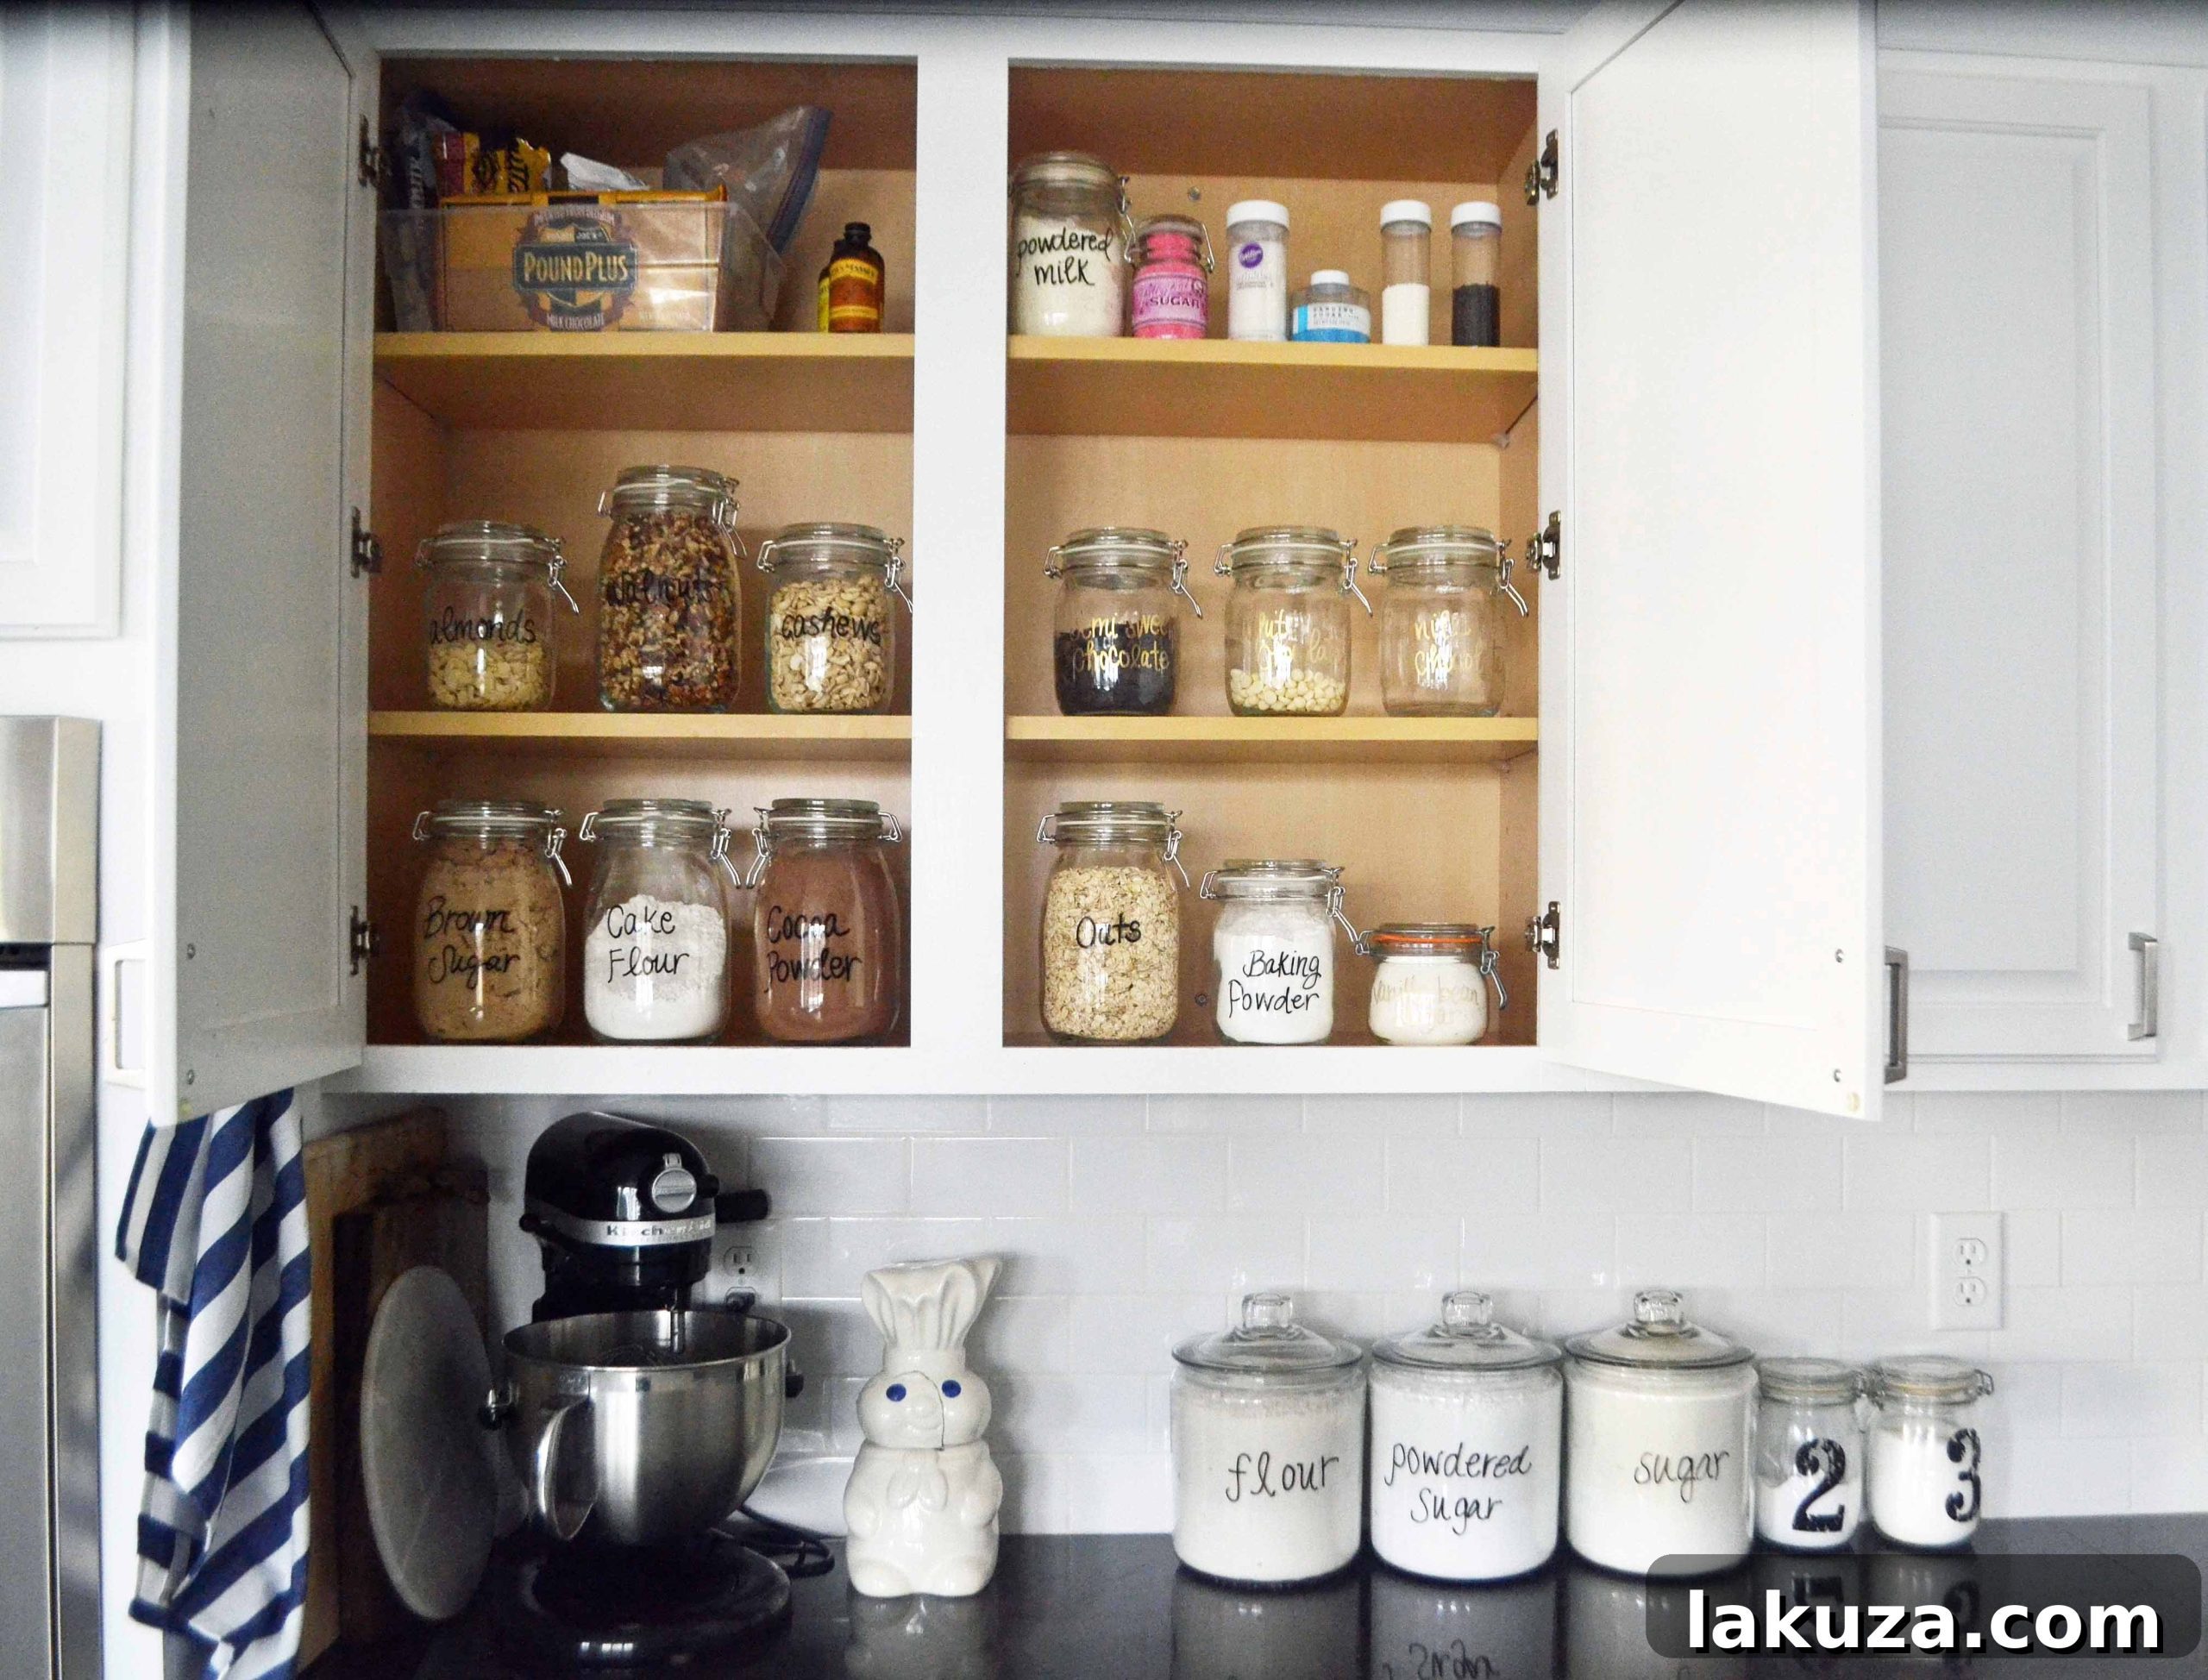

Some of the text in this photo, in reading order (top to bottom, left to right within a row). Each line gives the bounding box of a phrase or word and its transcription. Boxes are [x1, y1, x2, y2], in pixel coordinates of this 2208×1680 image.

[1017, 226, 1113, 277] powdered
[1034, 255, 1095, 285] milk
[1150, 297, 1200, 309] SUGAR
[431, 606, 536, 644] almonds
[781, 606, 881, 645] cashews
[1125, 613, 1174, 640] swee
[1072, 639, 1170, 674] chocolate
[423, 895, 516, 939] Brown
[606, 905, 675, 938] Cake
[767, 906, 850, 944] Cocoa
[1076, 912, 1142, 949] Oats
[429, 943, 520, 989] Sugar
[607, 946, 689, 983] Flour
[764, 947, 862, 994] Powder
[1243, 950, 1322, 990] Baking
[1228, 979, 1320, 1019] Powder
[607, 1219, 712, 1236] KichenAid
[1226, 1451, 1339, 1502] flour
[1383, 1442, 1532, 1488] powdered
[1634, 1449, 1730, 1503] sugar
[1791, 1437, 1847, 1533] 2
[1944, 1428, 1982, 1522] 3
[1410, 1489, 1503, 1536] Sugar
